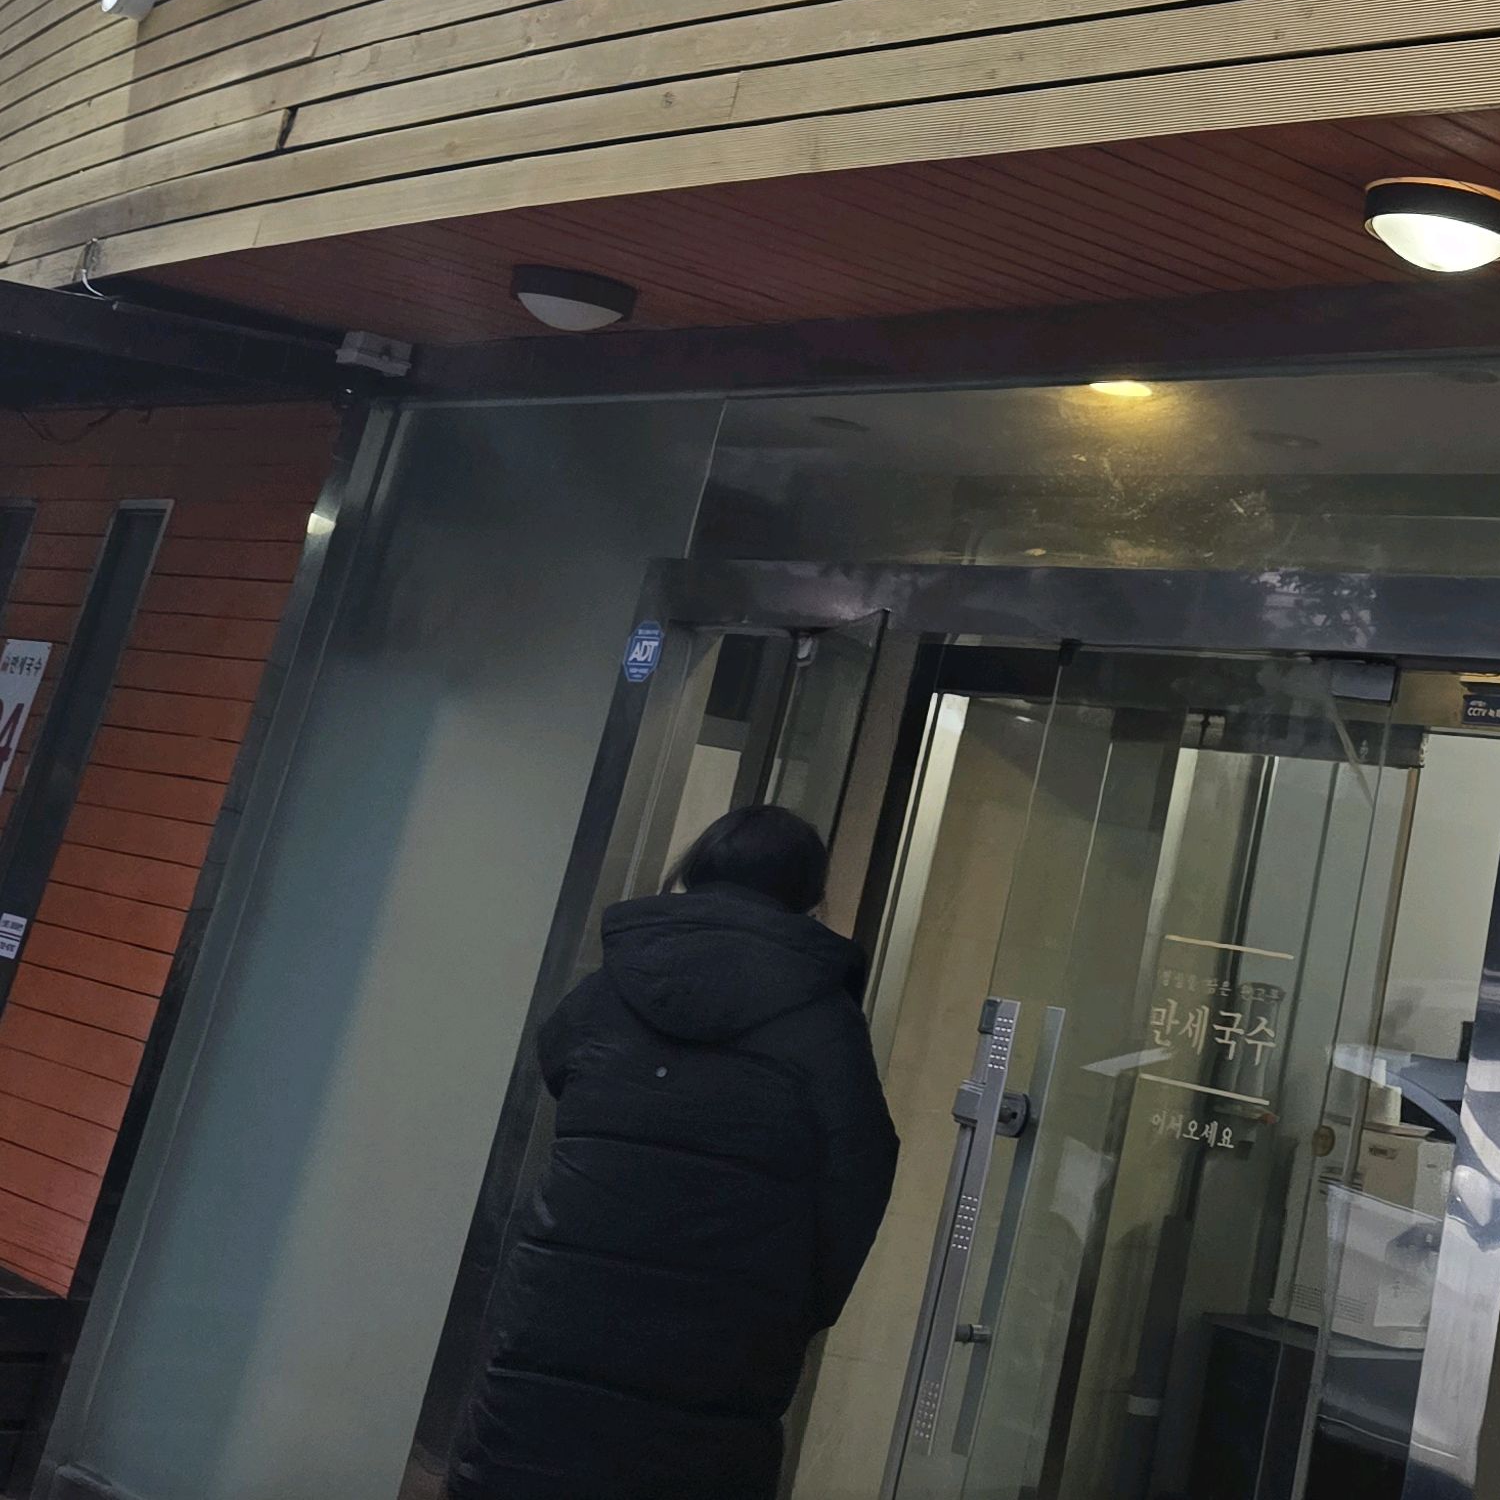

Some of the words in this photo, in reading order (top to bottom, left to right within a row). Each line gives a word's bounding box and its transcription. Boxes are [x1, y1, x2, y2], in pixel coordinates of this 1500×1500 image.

[628, 640, 660, 662] ADT
[1150, 998, 1277, 1067] 만세국수
[1151, 1108, 1235, 1150] 어서오세요
